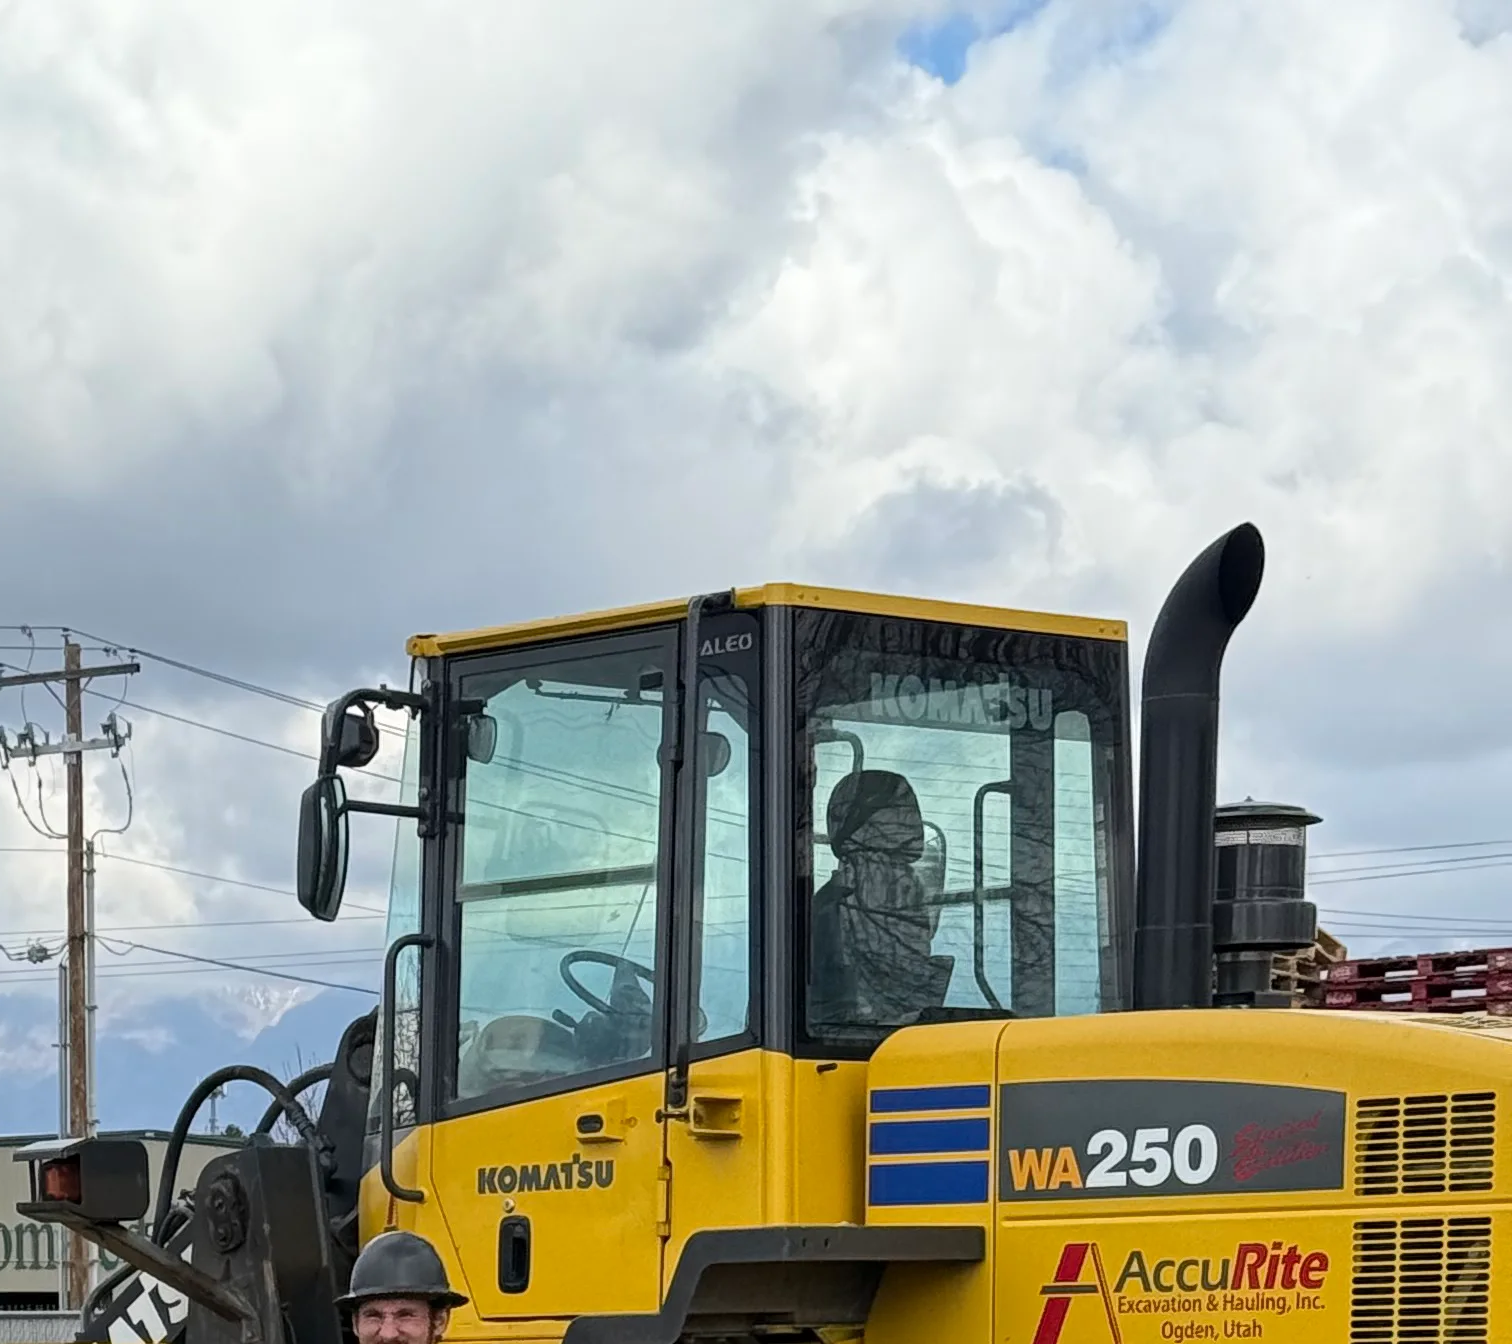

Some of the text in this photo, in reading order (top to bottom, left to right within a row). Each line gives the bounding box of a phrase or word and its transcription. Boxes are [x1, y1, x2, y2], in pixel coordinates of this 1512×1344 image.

[699, 632, 753, 657] ALEO
[870, 671, 1054, 731] KOMATSU
[477, 1153, 615, 1195] KOMATSU
[1113, 1241, 1330, 1293] AccuRite
[1117, 1292, 1326, 1316] Excavation & Hauling, Inc.
[1161, 1319, 1263, 1344] Ogden, Utah
